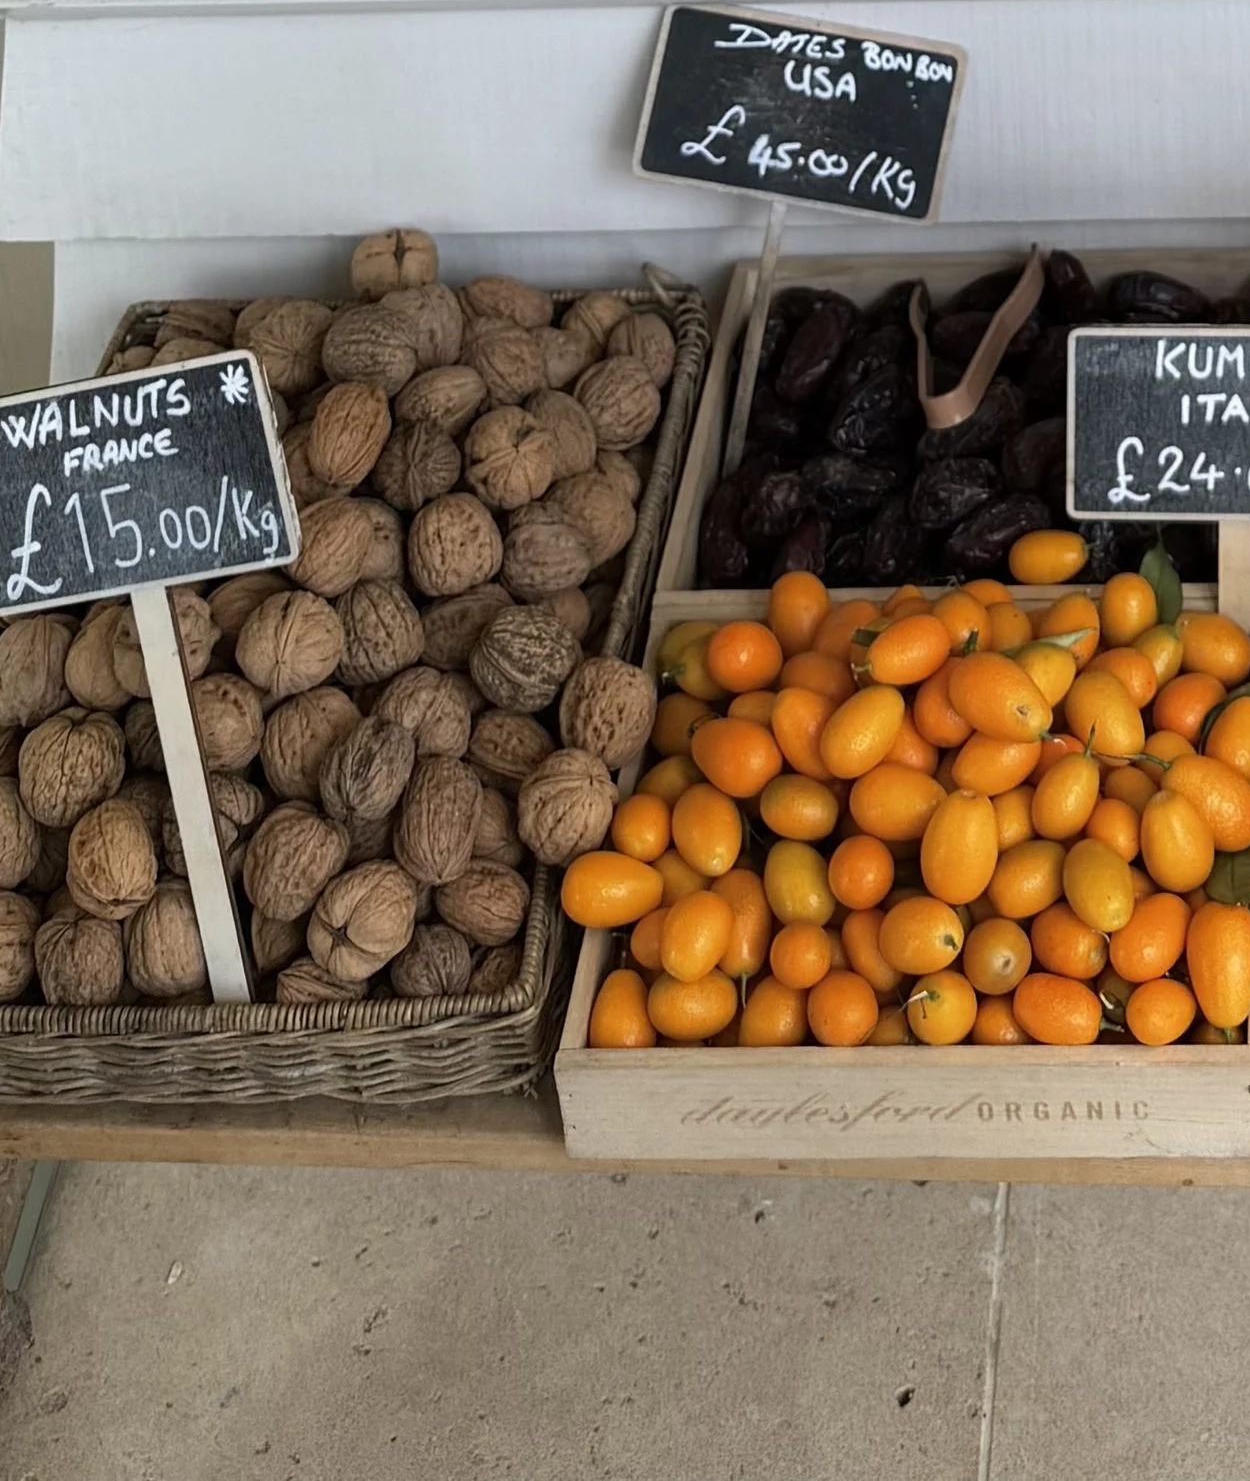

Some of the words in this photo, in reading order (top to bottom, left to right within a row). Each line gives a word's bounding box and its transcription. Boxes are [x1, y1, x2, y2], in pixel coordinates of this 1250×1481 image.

[714, 23, 846, 60] DATES
[784, 60, 857, 102] USA
[1, 378, 192, 450] WALNUTS
[63, 428, 179, 477] FRANCE
[977, 1101, 1150, 1122] ORGANIC
